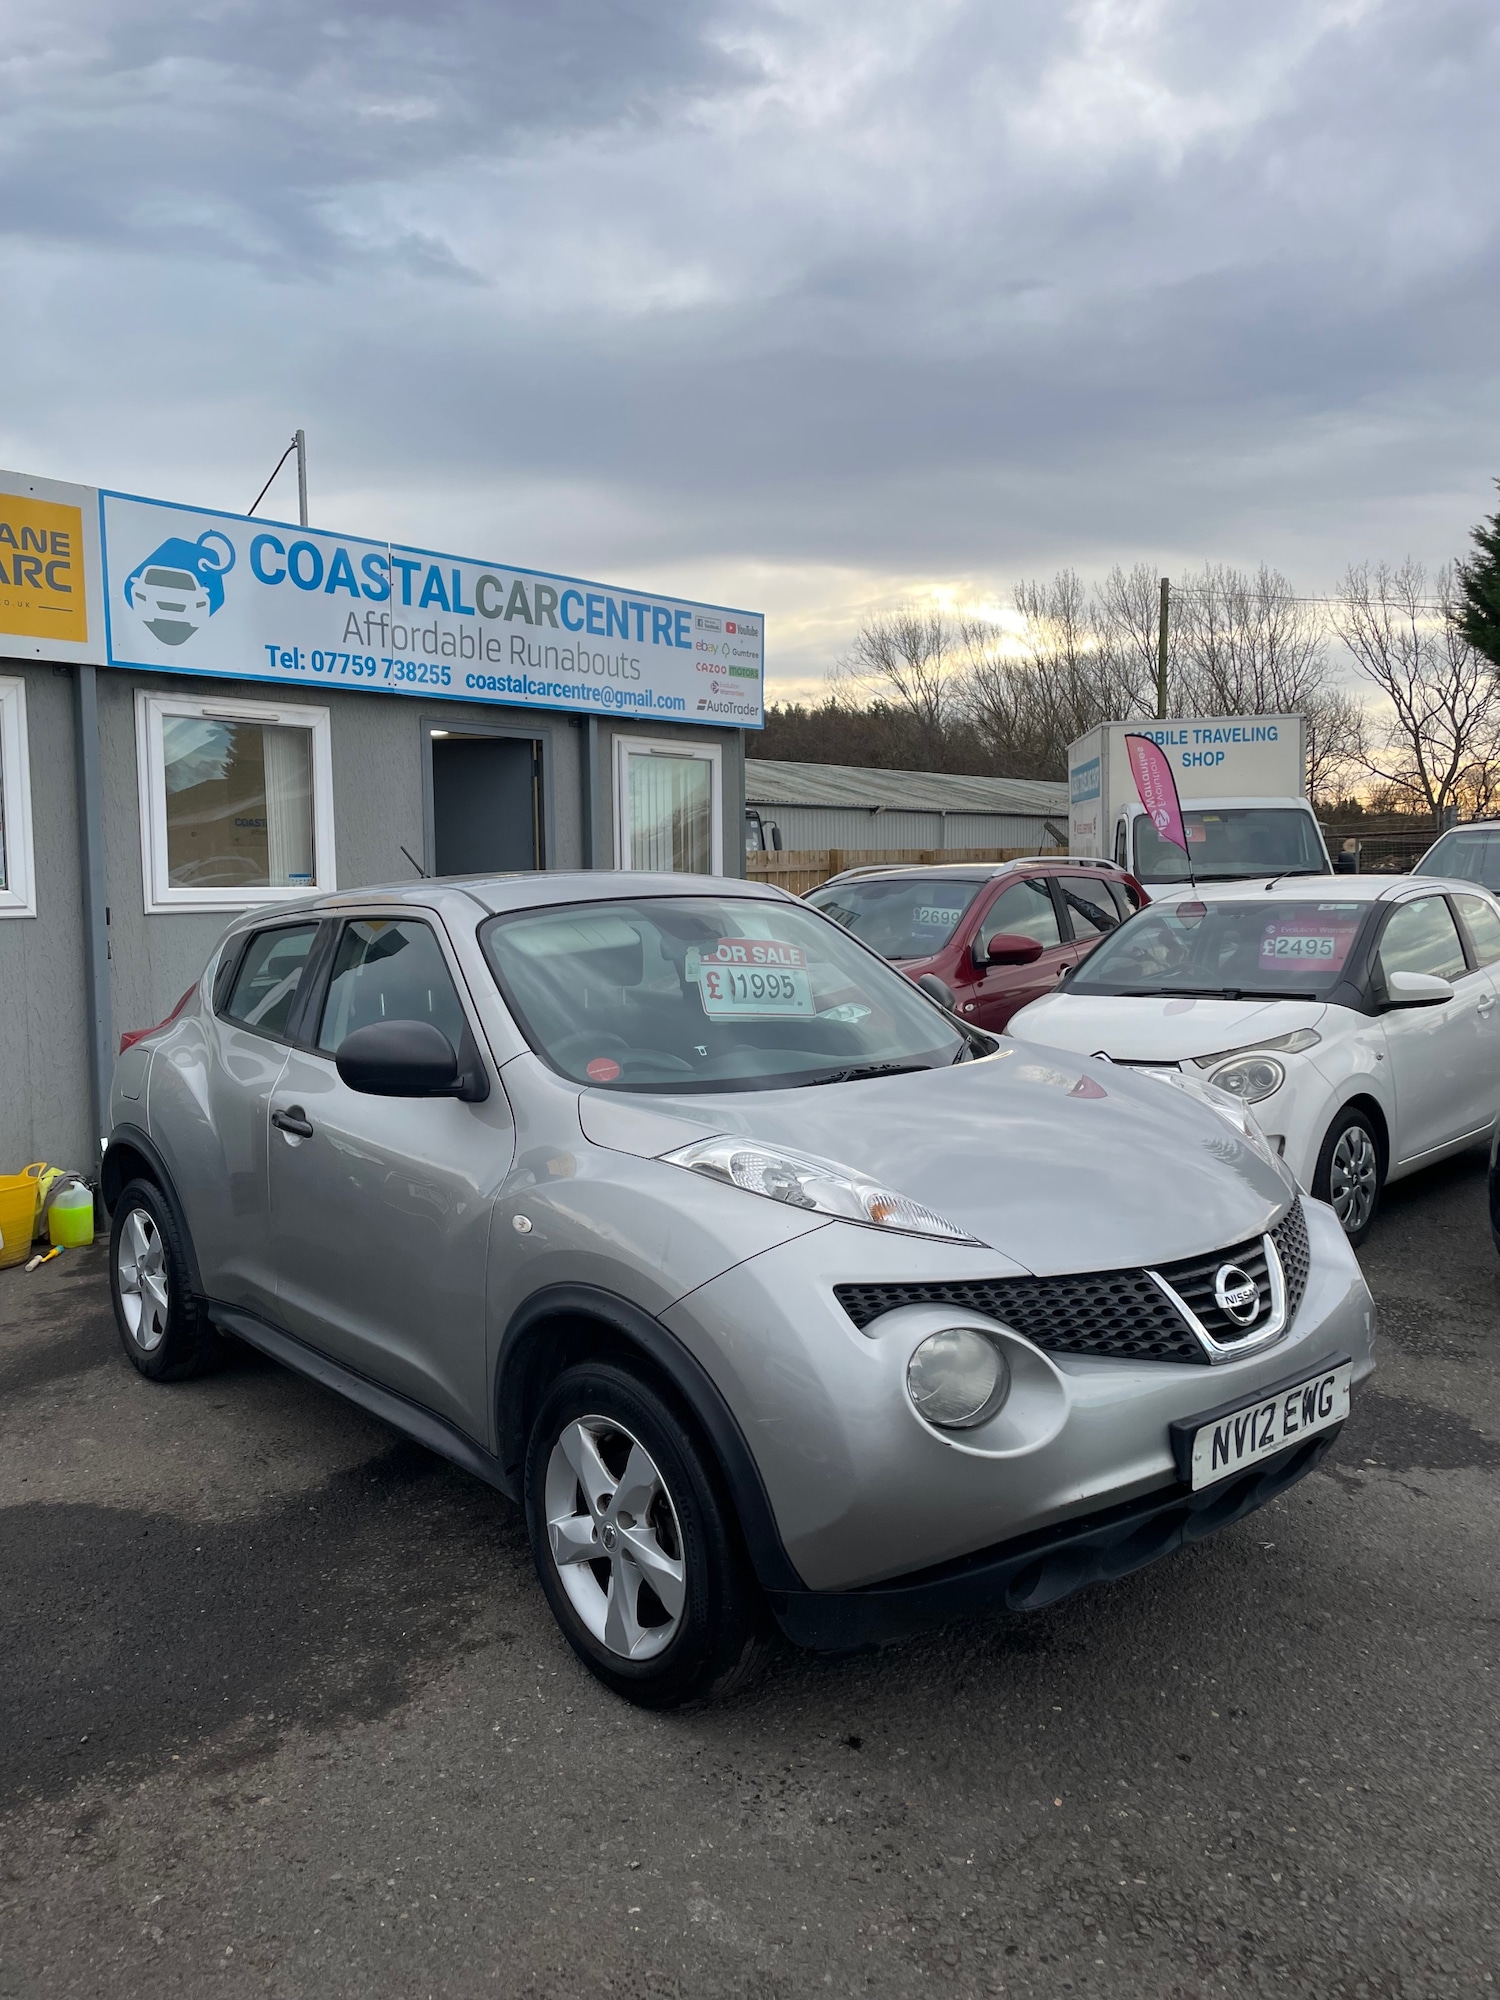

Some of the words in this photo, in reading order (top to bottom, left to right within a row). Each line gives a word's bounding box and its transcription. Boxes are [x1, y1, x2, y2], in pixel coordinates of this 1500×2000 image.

[250, 533, 692, 649] COASTALCARCENTRE
[737, 624, 758, 637] YouTube
[342, 611, 501, 662] Affordable
[510, 635, 641, 680] Runabouts
[696, 639, 718, 655] ebay
[732, 648, 759, 658] Gumtree
[696, 662, 727, 674] CAZOO
[264, 644, 305, 670] Tel:
[311, 650, 376, 677] 07759
[381, 658, 451, 685] 738255
[465, 673, 685, 710] coastalcarcentre@gmail.com
[707, 700, 759, 716] AutoTrader
[1131, 730, 1188, 746] OBILE
[1193, 726, 1278, 744] TRAVELING
[1182, 751, 1225, 767] SHOP
[752, 946, 801, 965] SALE
[1212, 1402, 1276, 1471] NV12
[1283, 1375, 1335, 1436] EWG
